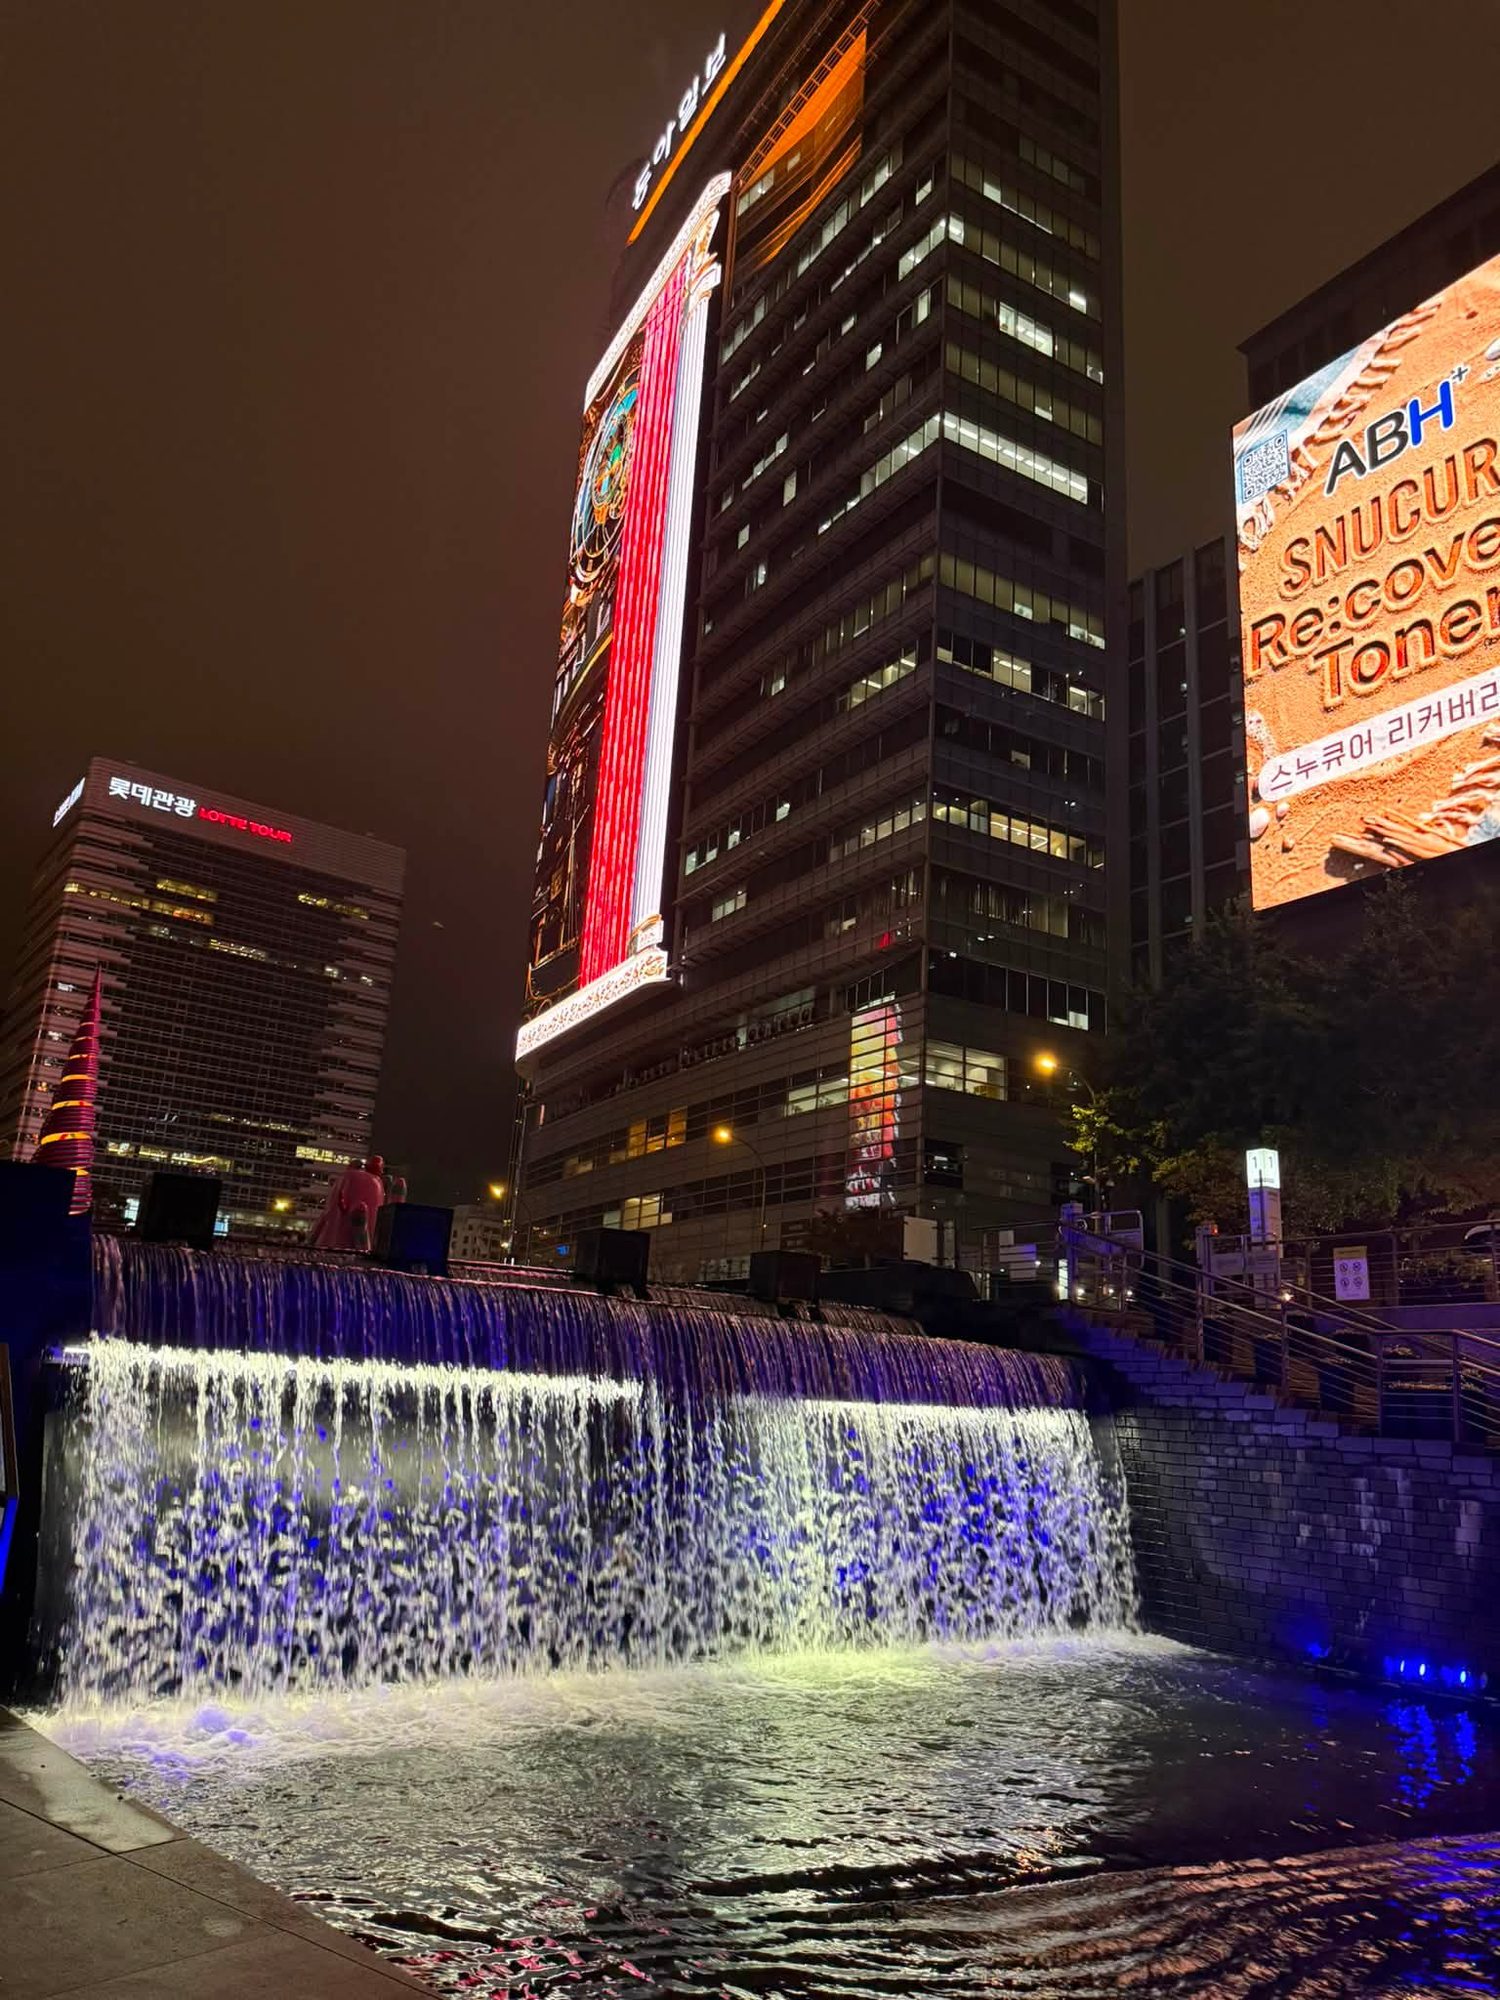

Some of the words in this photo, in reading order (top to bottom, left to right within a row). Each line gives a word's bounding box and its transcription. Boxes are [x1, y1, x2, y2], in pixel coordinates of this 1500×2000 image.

[1284, 437, 1500, 590] SNUCUR
[1270, 729, 1373, 791] 스누큐어
[109, 776, 197, 817] 롯데관광
[199, 807, 248, 830] LOTTE
[249, 821, 292, 843] TOUR
